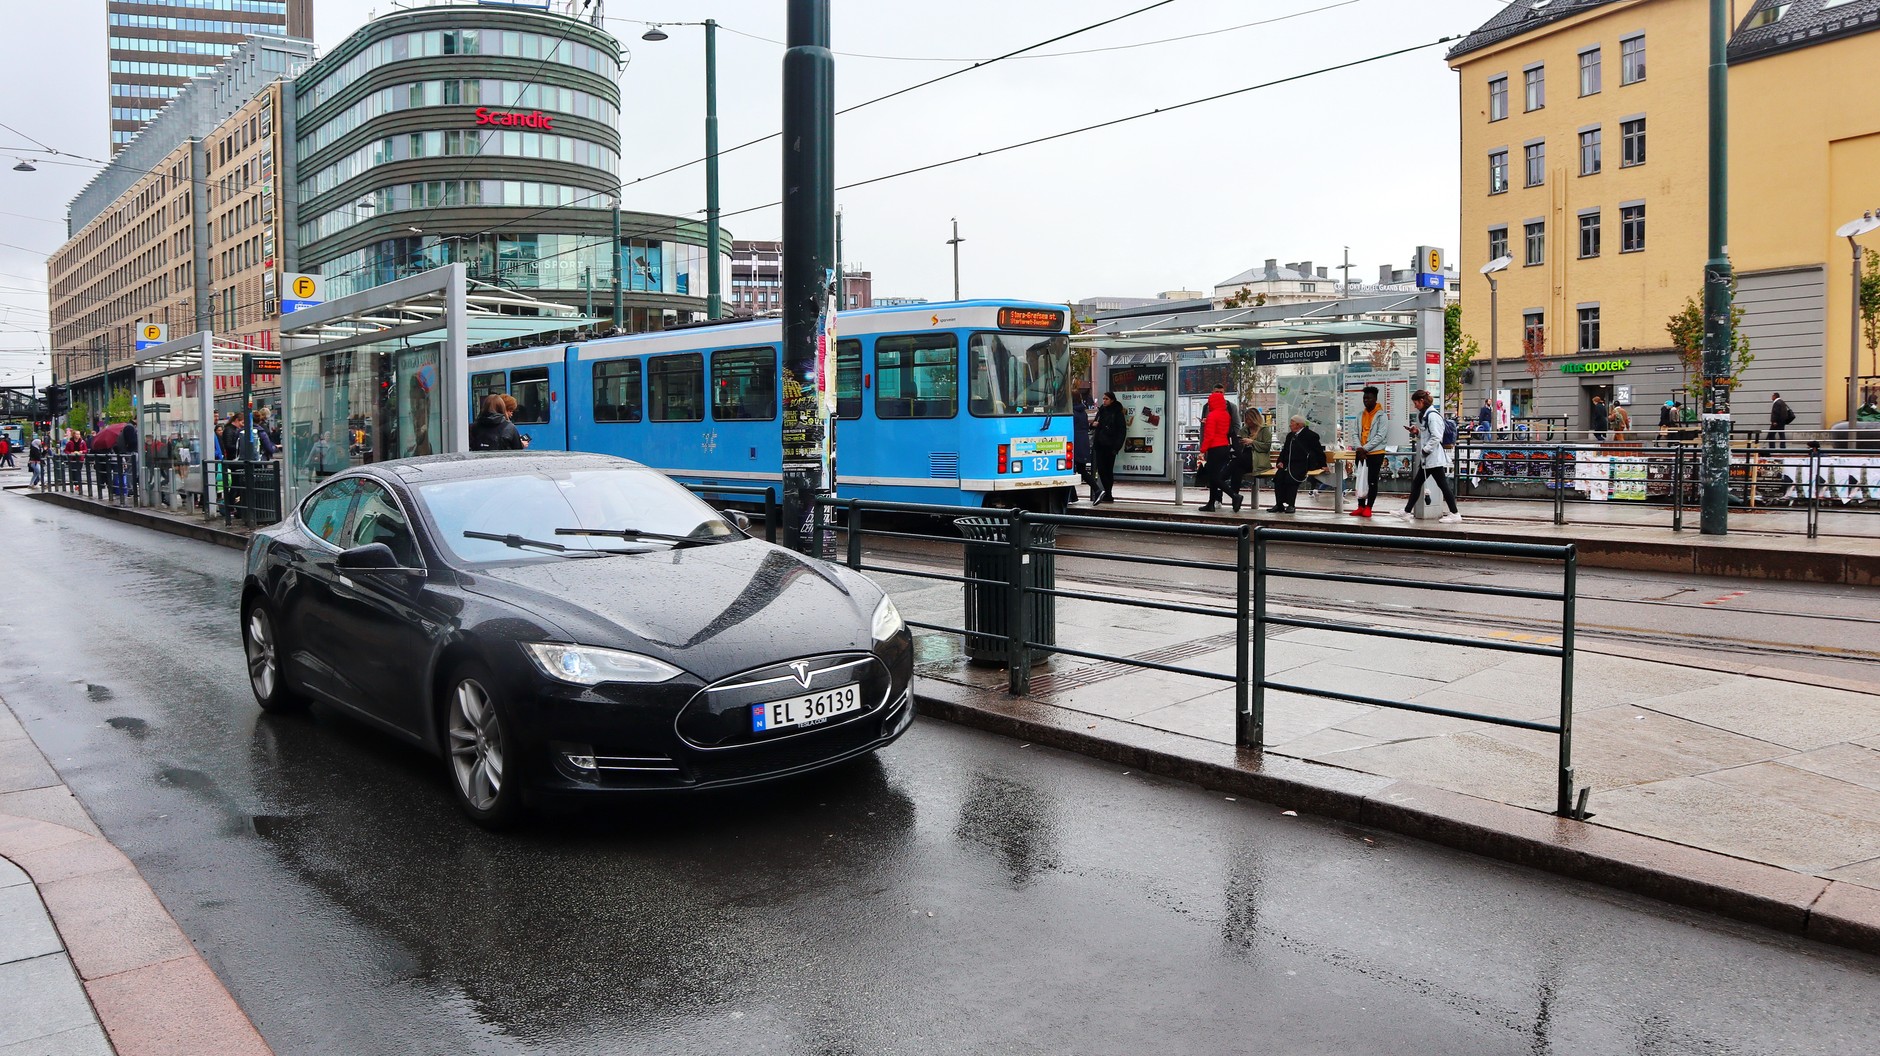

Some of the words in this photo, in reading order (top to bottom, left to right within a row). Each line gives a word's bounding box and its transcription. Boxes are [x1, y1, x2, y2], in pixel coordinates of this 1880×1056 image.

[475, 107, 553, 130] Scandic
[543, 259, 585, 269] SPORT
[299, 280, 309, 294] F
[1362, 283, 1378, 291] HOTEL
[1379, 283, 1397, 291] GRAND
[148, 328, 155, 337] F
[1267, 348, 1328, 360] Jernbanetorget
[1618, 391, 1629, 400] 24
[1032, 457, 1049, 471] 132
[773, 703, 794, 725] EL
[804, 688, 854, 718] 36139
